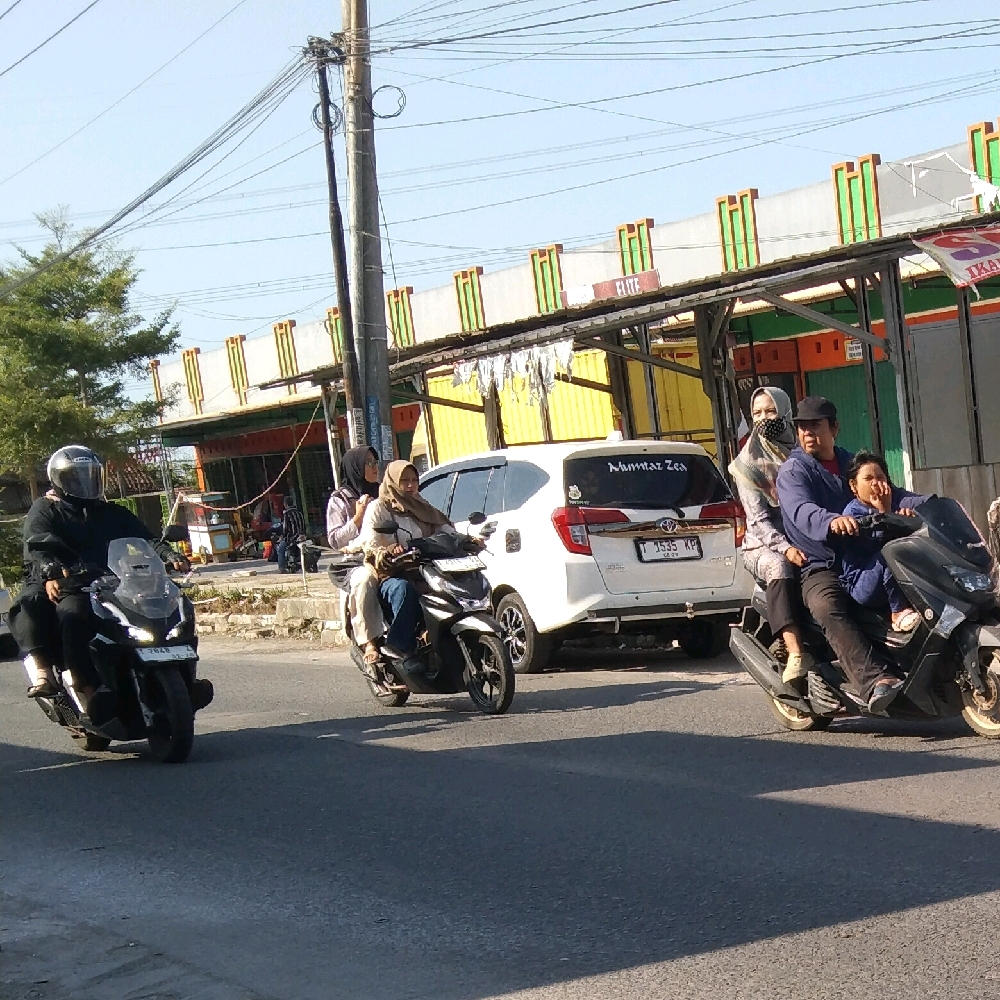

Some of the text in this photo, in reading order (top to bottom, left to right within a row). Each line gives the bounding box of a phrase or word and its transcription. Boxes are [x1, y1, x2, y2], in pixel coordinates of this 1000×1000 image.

[608, 459, 688, 473] Mumtaz Zea
[639, 538, 697, 554] T 1535 KP
